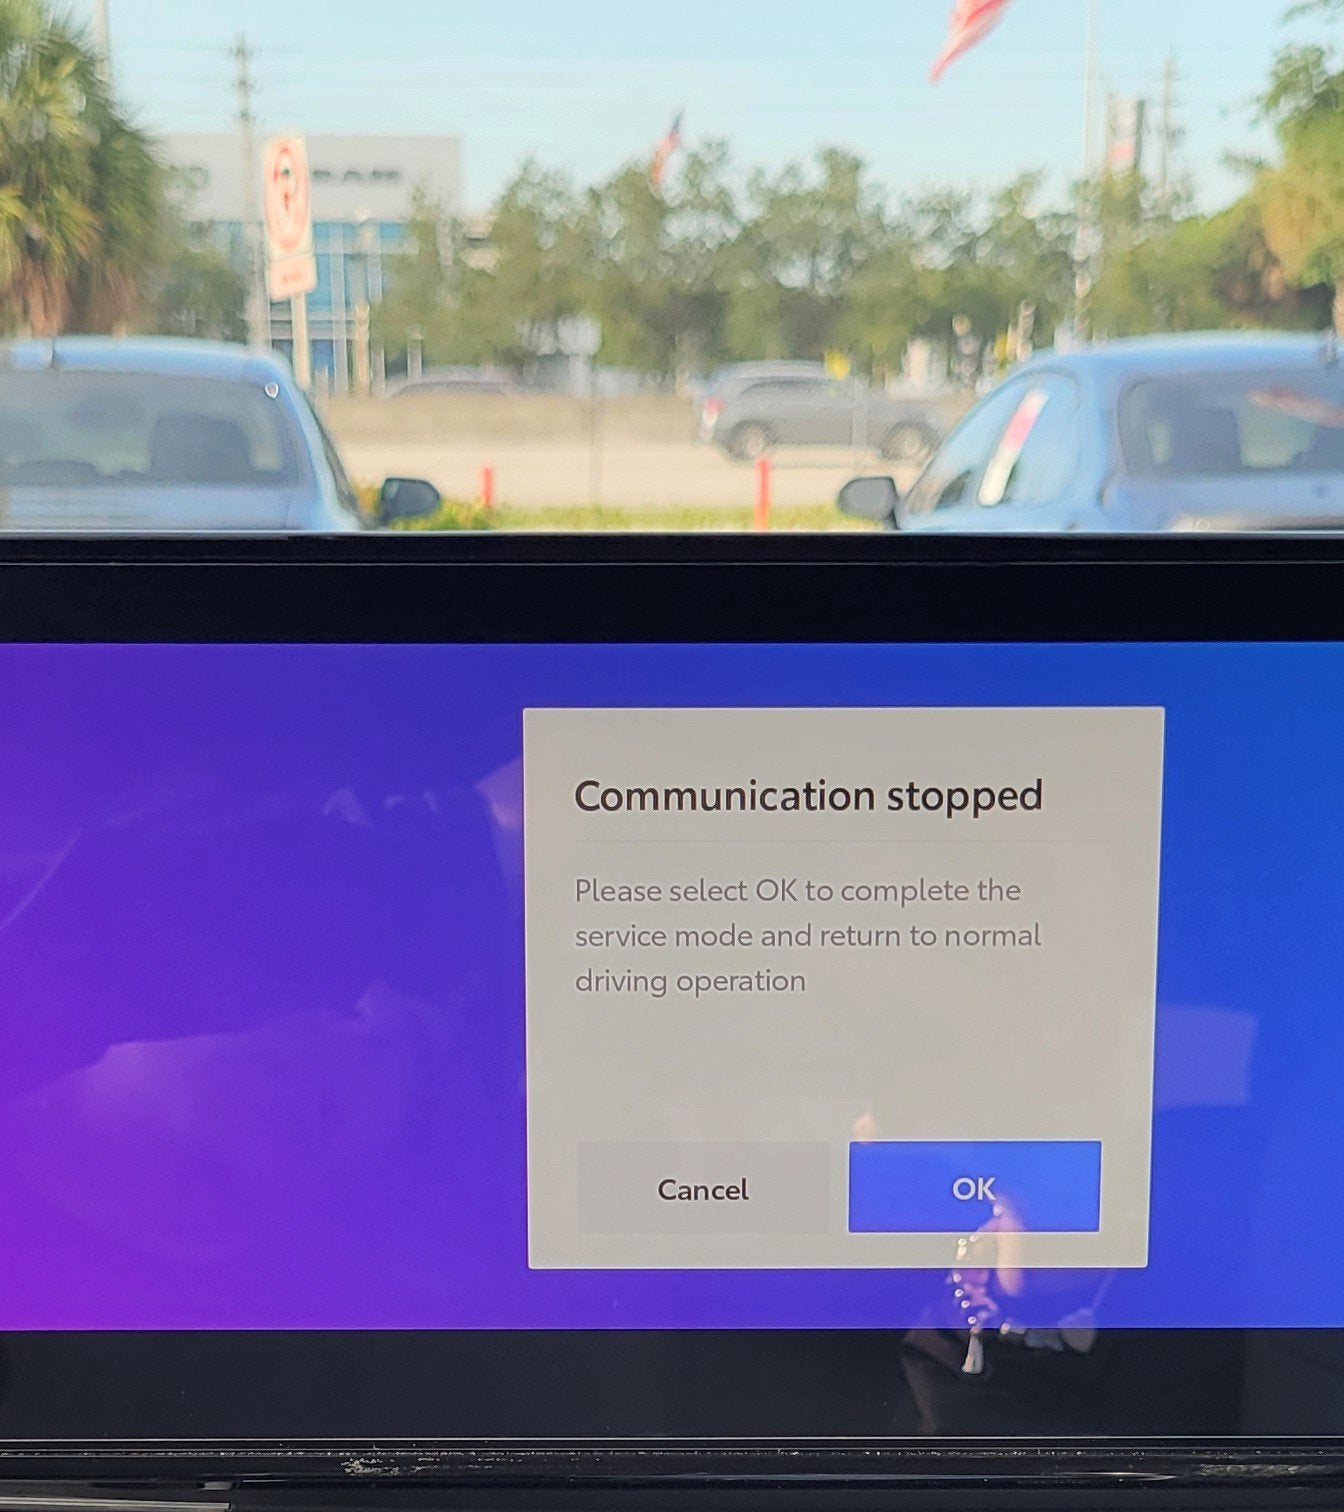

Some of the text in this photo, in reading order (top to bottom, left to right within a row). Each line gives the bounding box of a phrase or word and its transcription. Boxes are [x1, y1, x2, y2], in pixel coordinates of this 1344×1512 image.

[575, 778, 1043, 818] Communication stopped
[576, 879, 1021, 907] Please select OK to complete the
[575, 924, 1042, 947] service mode and return to normal
[575, 969, 806, 997] driving operation
[657, 1176, 997, 1202] Cancel OK
